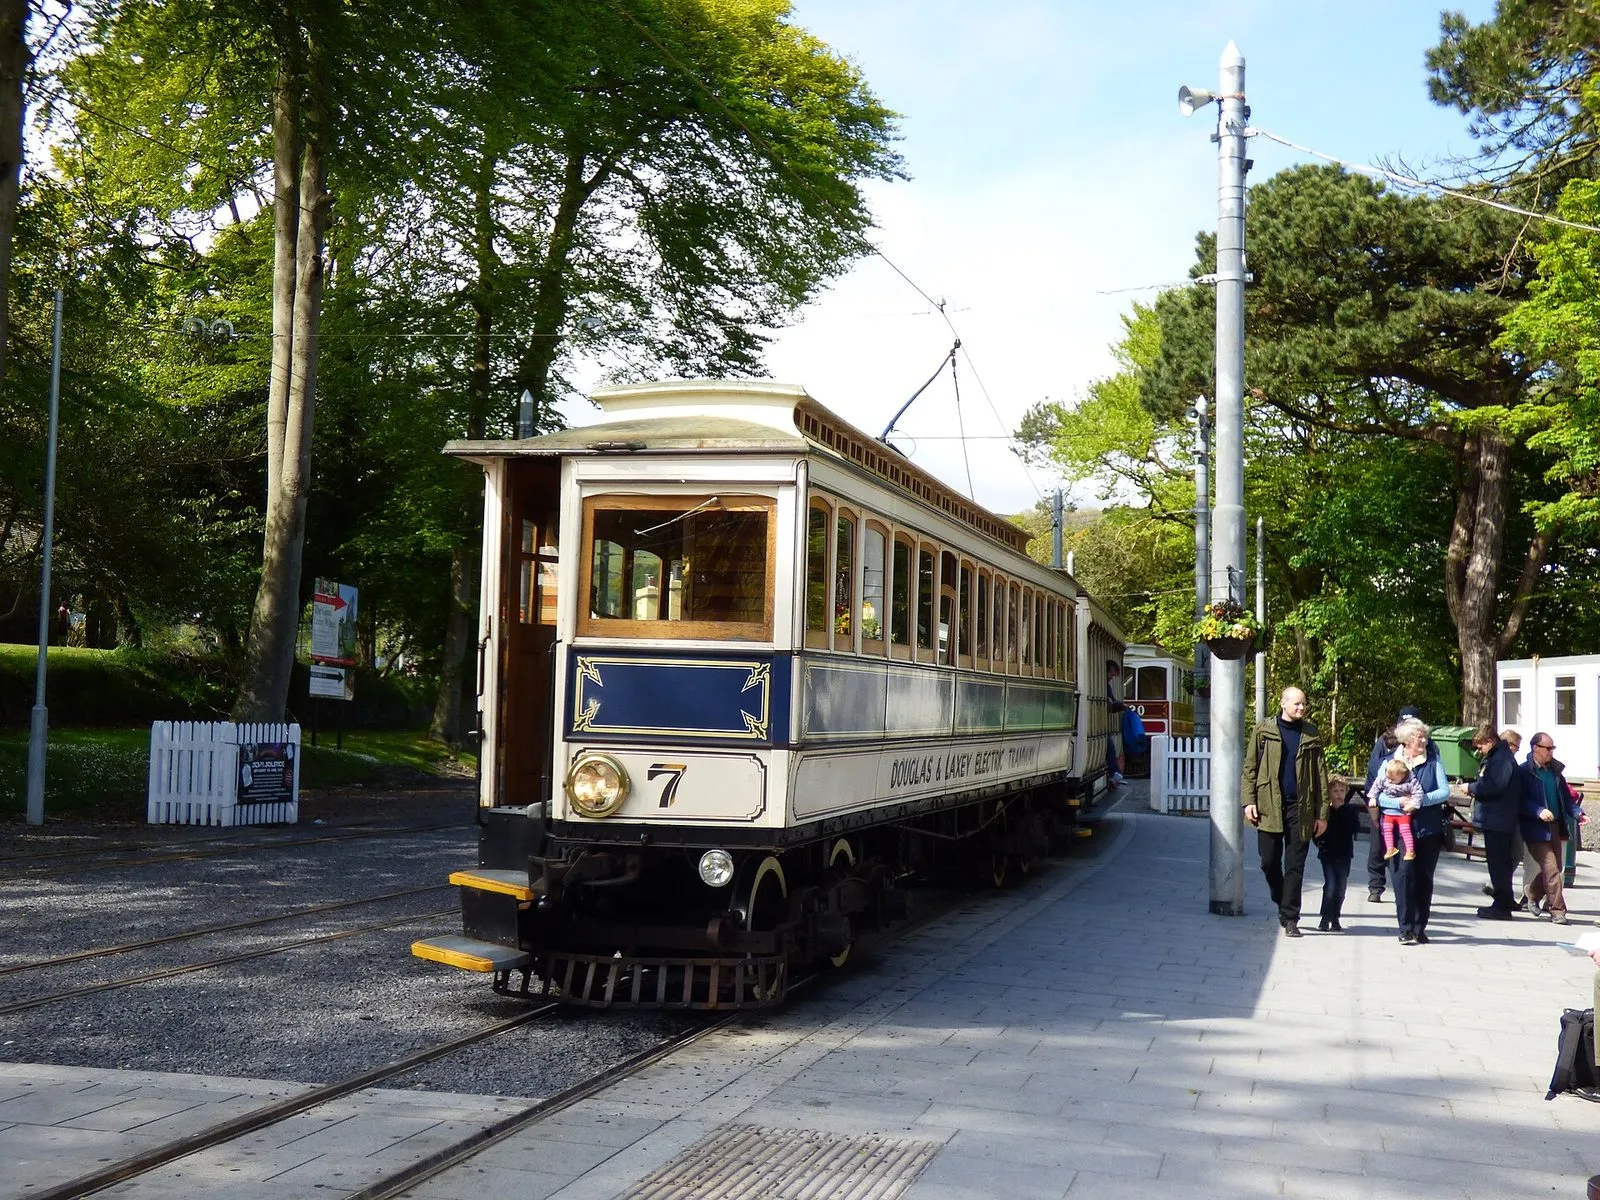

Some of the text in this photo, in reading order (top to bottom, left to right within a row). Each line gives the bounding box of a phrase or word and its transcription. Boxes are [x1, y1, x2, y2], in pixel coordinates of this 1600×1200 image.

[647, 763, 688, 808] 7
[890, 745, 1035, 789] DOUGLAS & LAXEY ELECTRIC TRAMWAY
